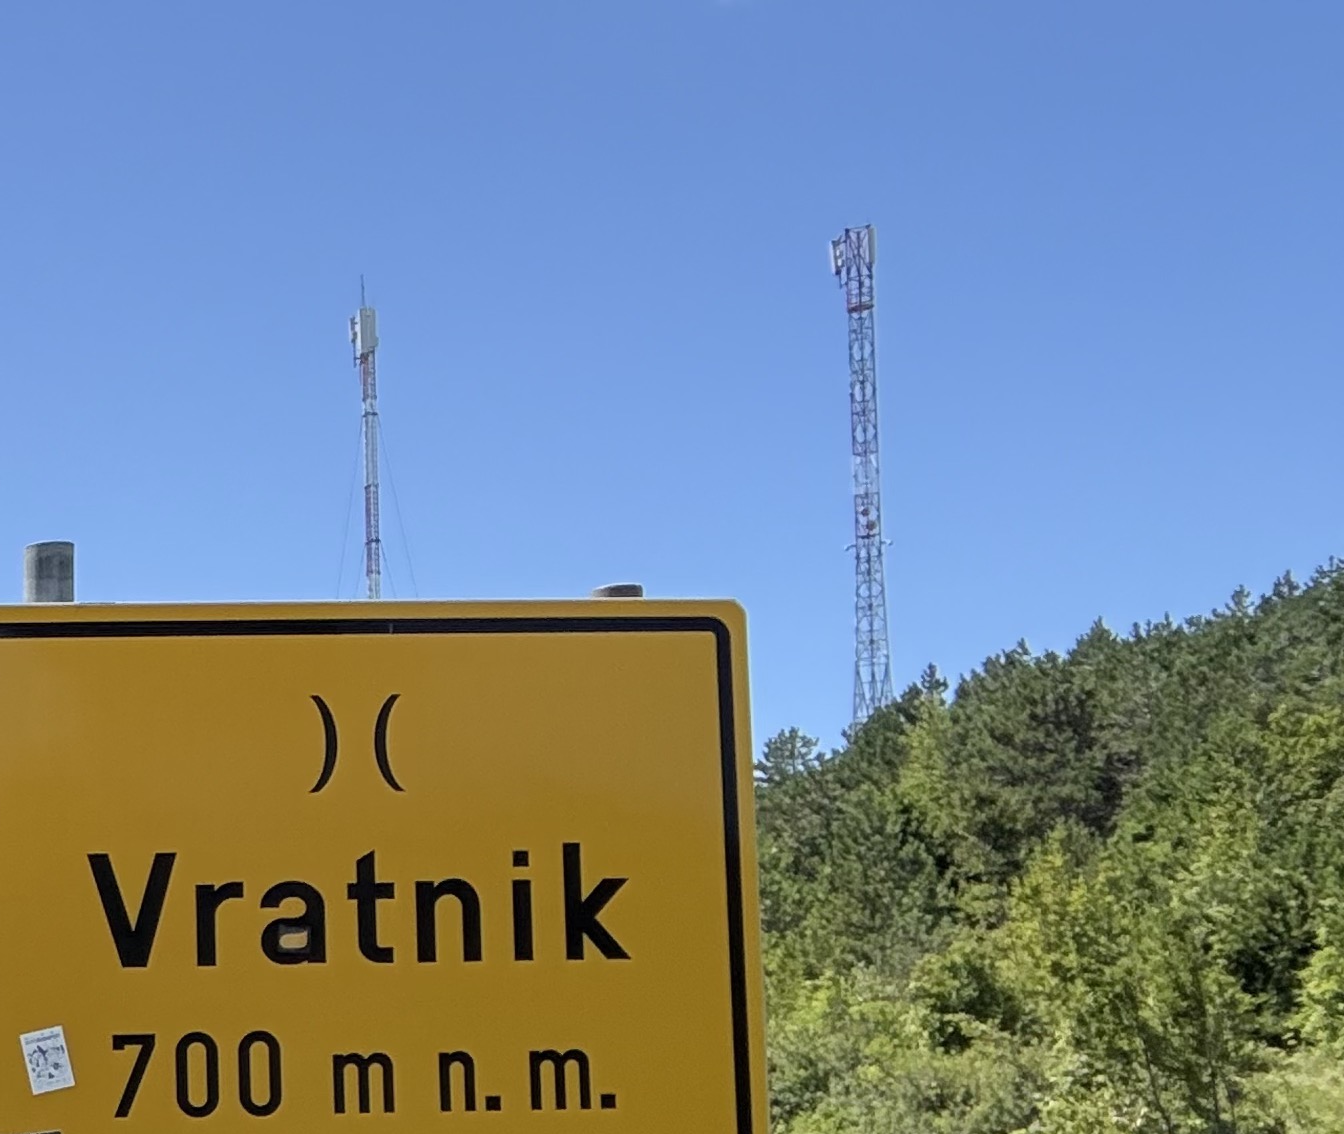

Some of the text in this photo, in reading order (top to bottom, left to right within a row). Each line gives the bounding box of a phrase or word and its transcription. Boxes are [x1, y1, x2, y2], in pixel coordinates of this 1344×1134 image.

[86, 842, 631, 968] Vratnik
[112, 1030, 616, 1118] 700 m n. m.
